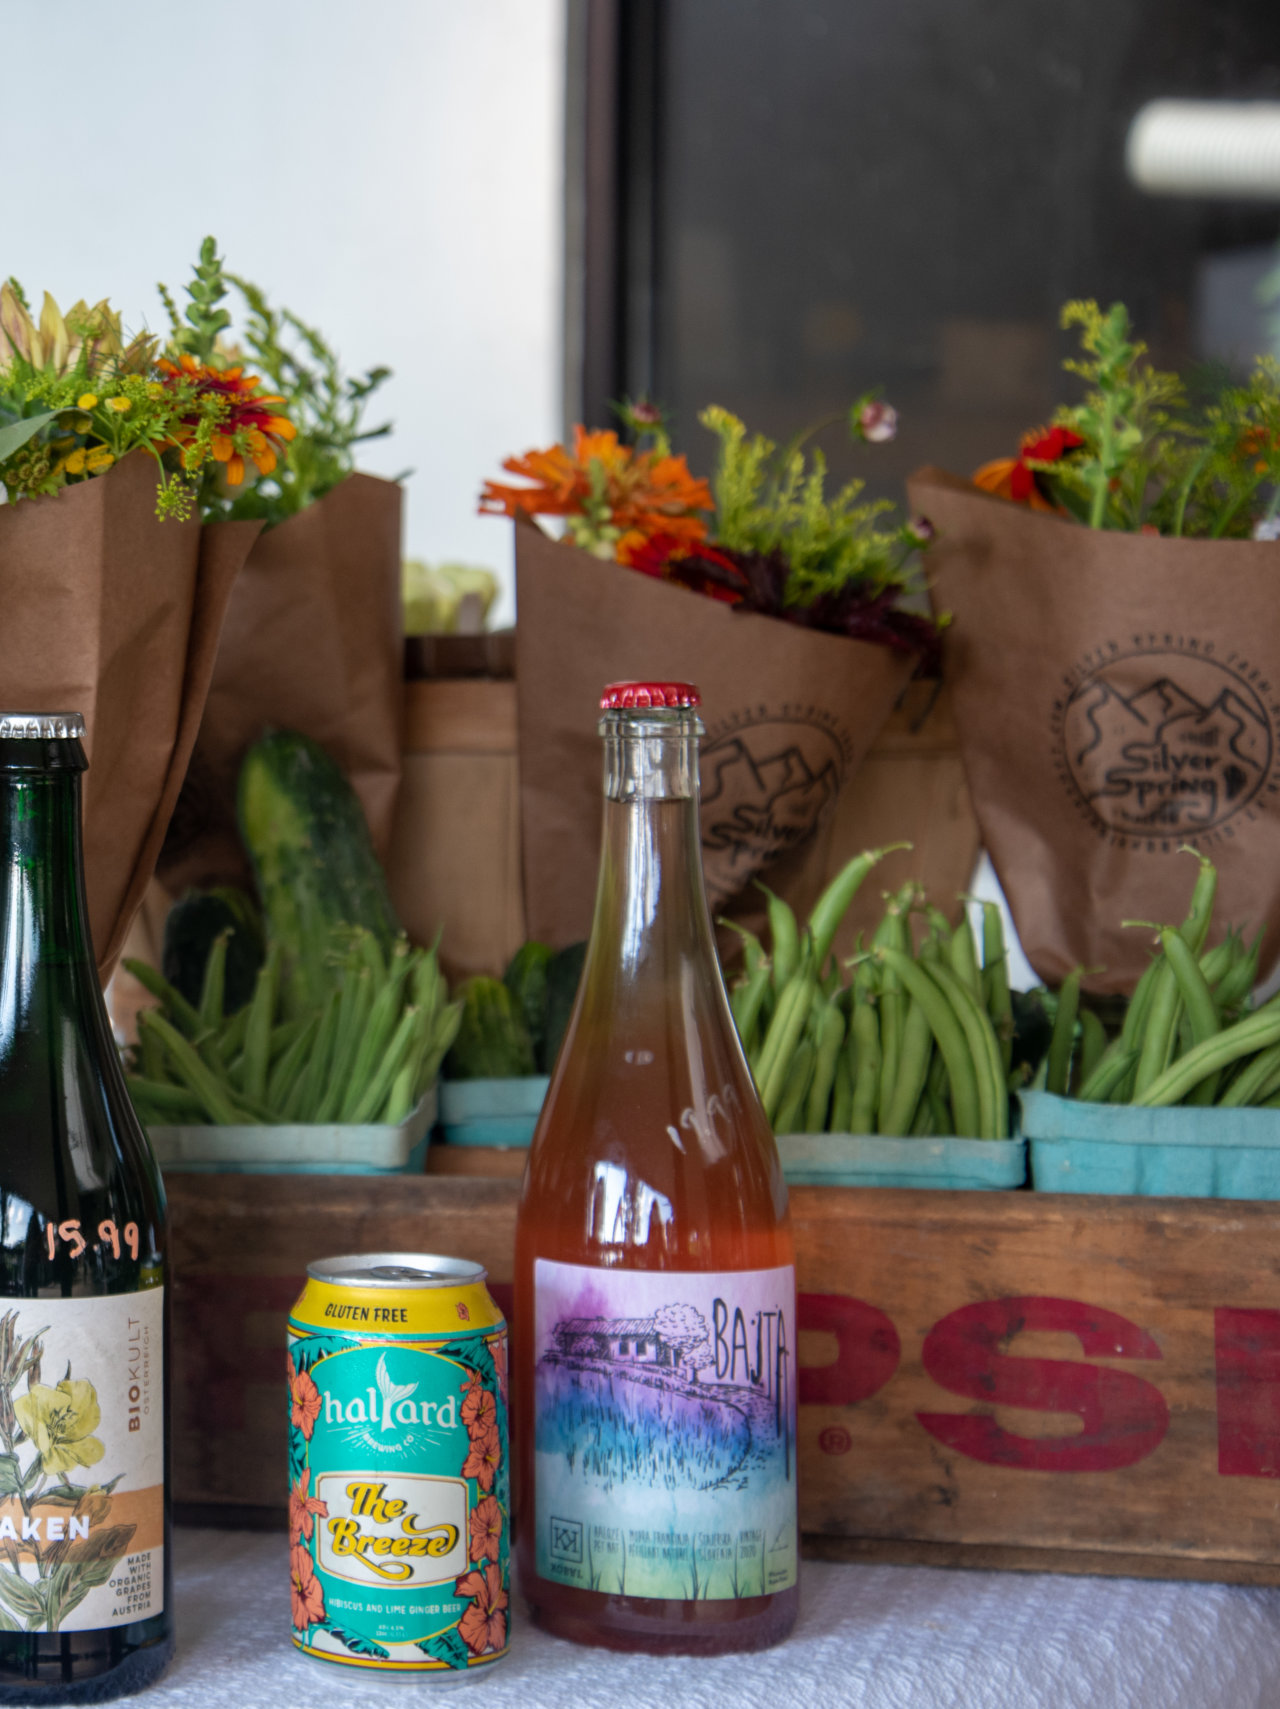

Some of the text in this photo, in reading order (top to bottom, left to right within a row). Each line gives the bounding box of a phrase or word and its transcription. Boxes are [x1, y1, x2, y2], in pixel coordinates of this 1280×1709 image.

[1121, 741, 1220, 773] Silver
[1105, 767, 1218, 823] Spring
[324, 1302, 408, 1323] GLUTEN FREE
[128, 1316, 140, 1433] BIOKULT
[324, 1351, 458, 1433] halyard
[712, 1297, 791, 1482] BAJTA
[363, 1432, 403, 1454] BREWING
[346, 1482, 407, 1523] The
[327, 1513, 460, 1581] Breeze
[128, 1552, 151, 1566] MADE
[129, 1562, 151, 1574] WITH
[109, 1572, 151, 1588] ORGANIC
[116, 1581, 151, 1596] GRAPES
[127, 1591, 151, 1604] FROM
[329, 1598, 461, 1615] HIBISCUS AND LIME GINGER BEER
[112, 1600, 151, 1617] AUSTRIA
